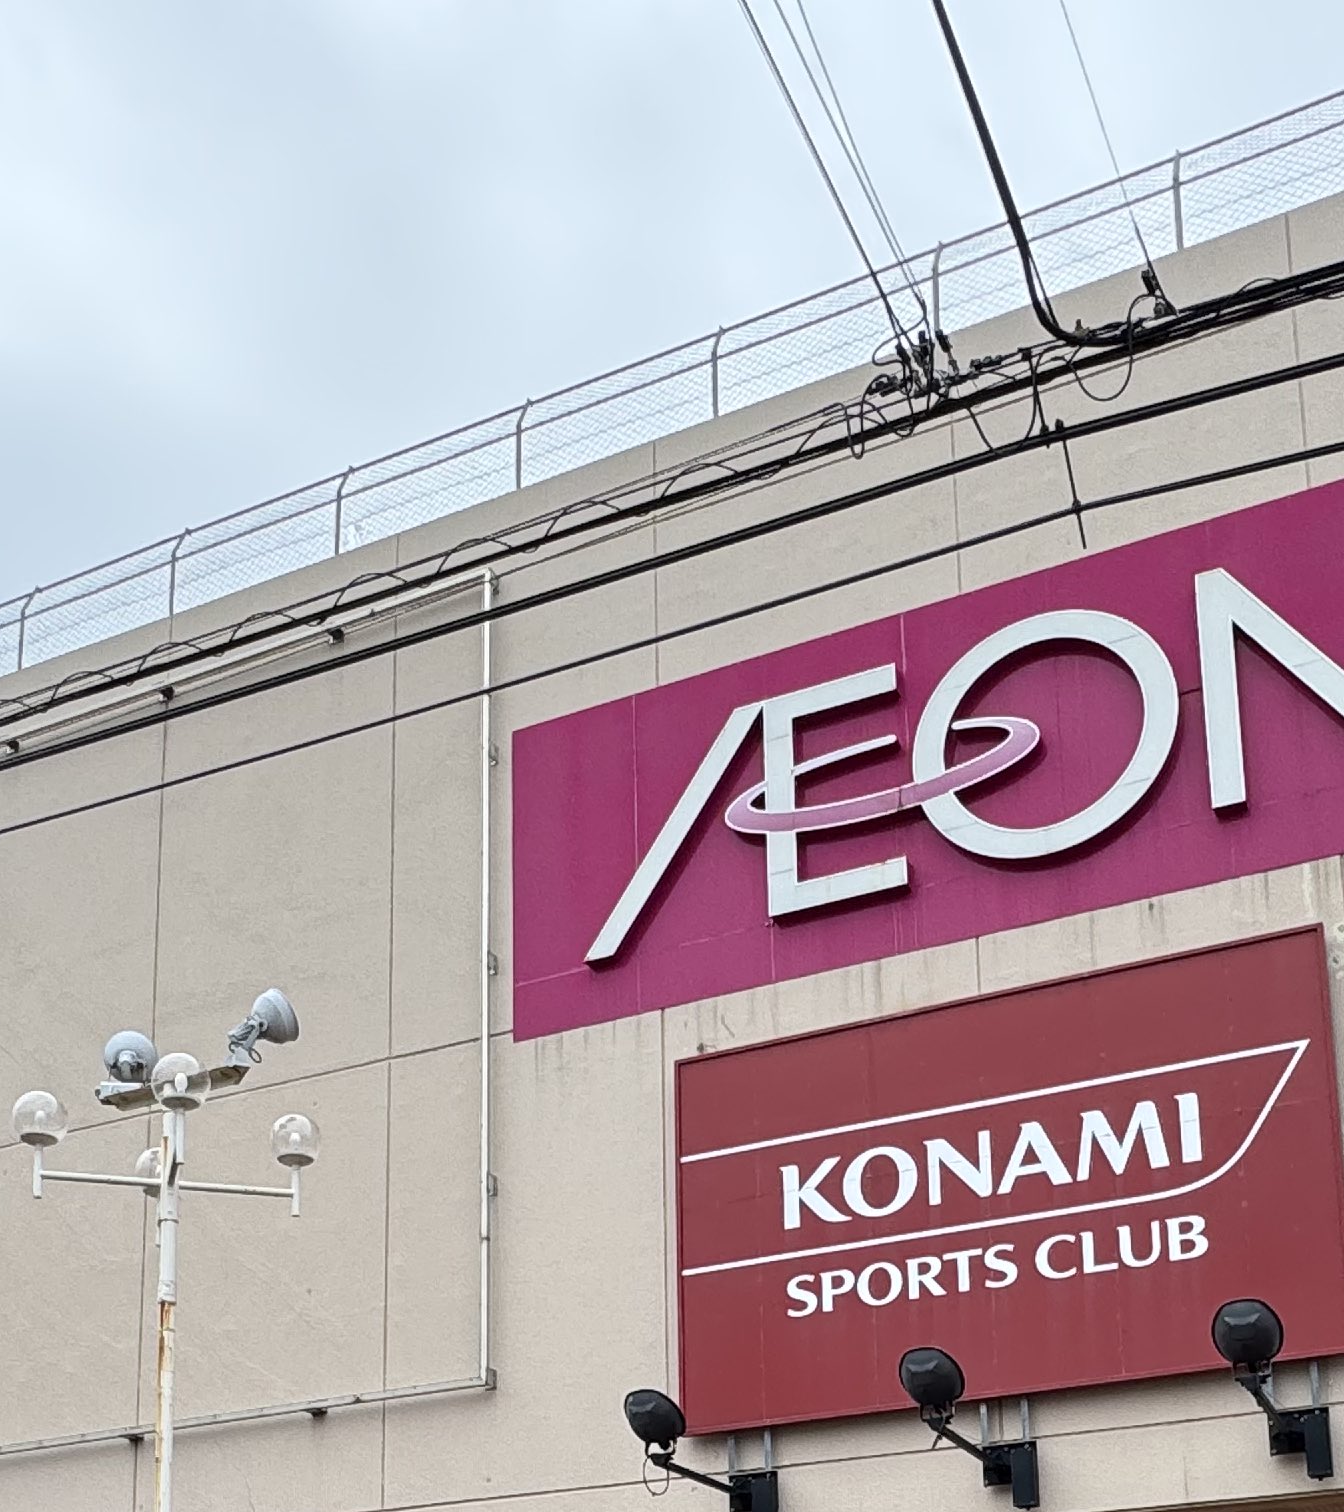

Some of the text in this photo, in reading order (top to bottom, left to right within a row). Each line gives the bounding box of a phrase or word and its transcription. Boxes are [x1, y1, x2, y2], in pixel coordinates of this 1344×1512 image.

[781, 1091, 1204, 1231] KONAMI
[786, 1214, 1210, 1318] SPORTS CLUB
